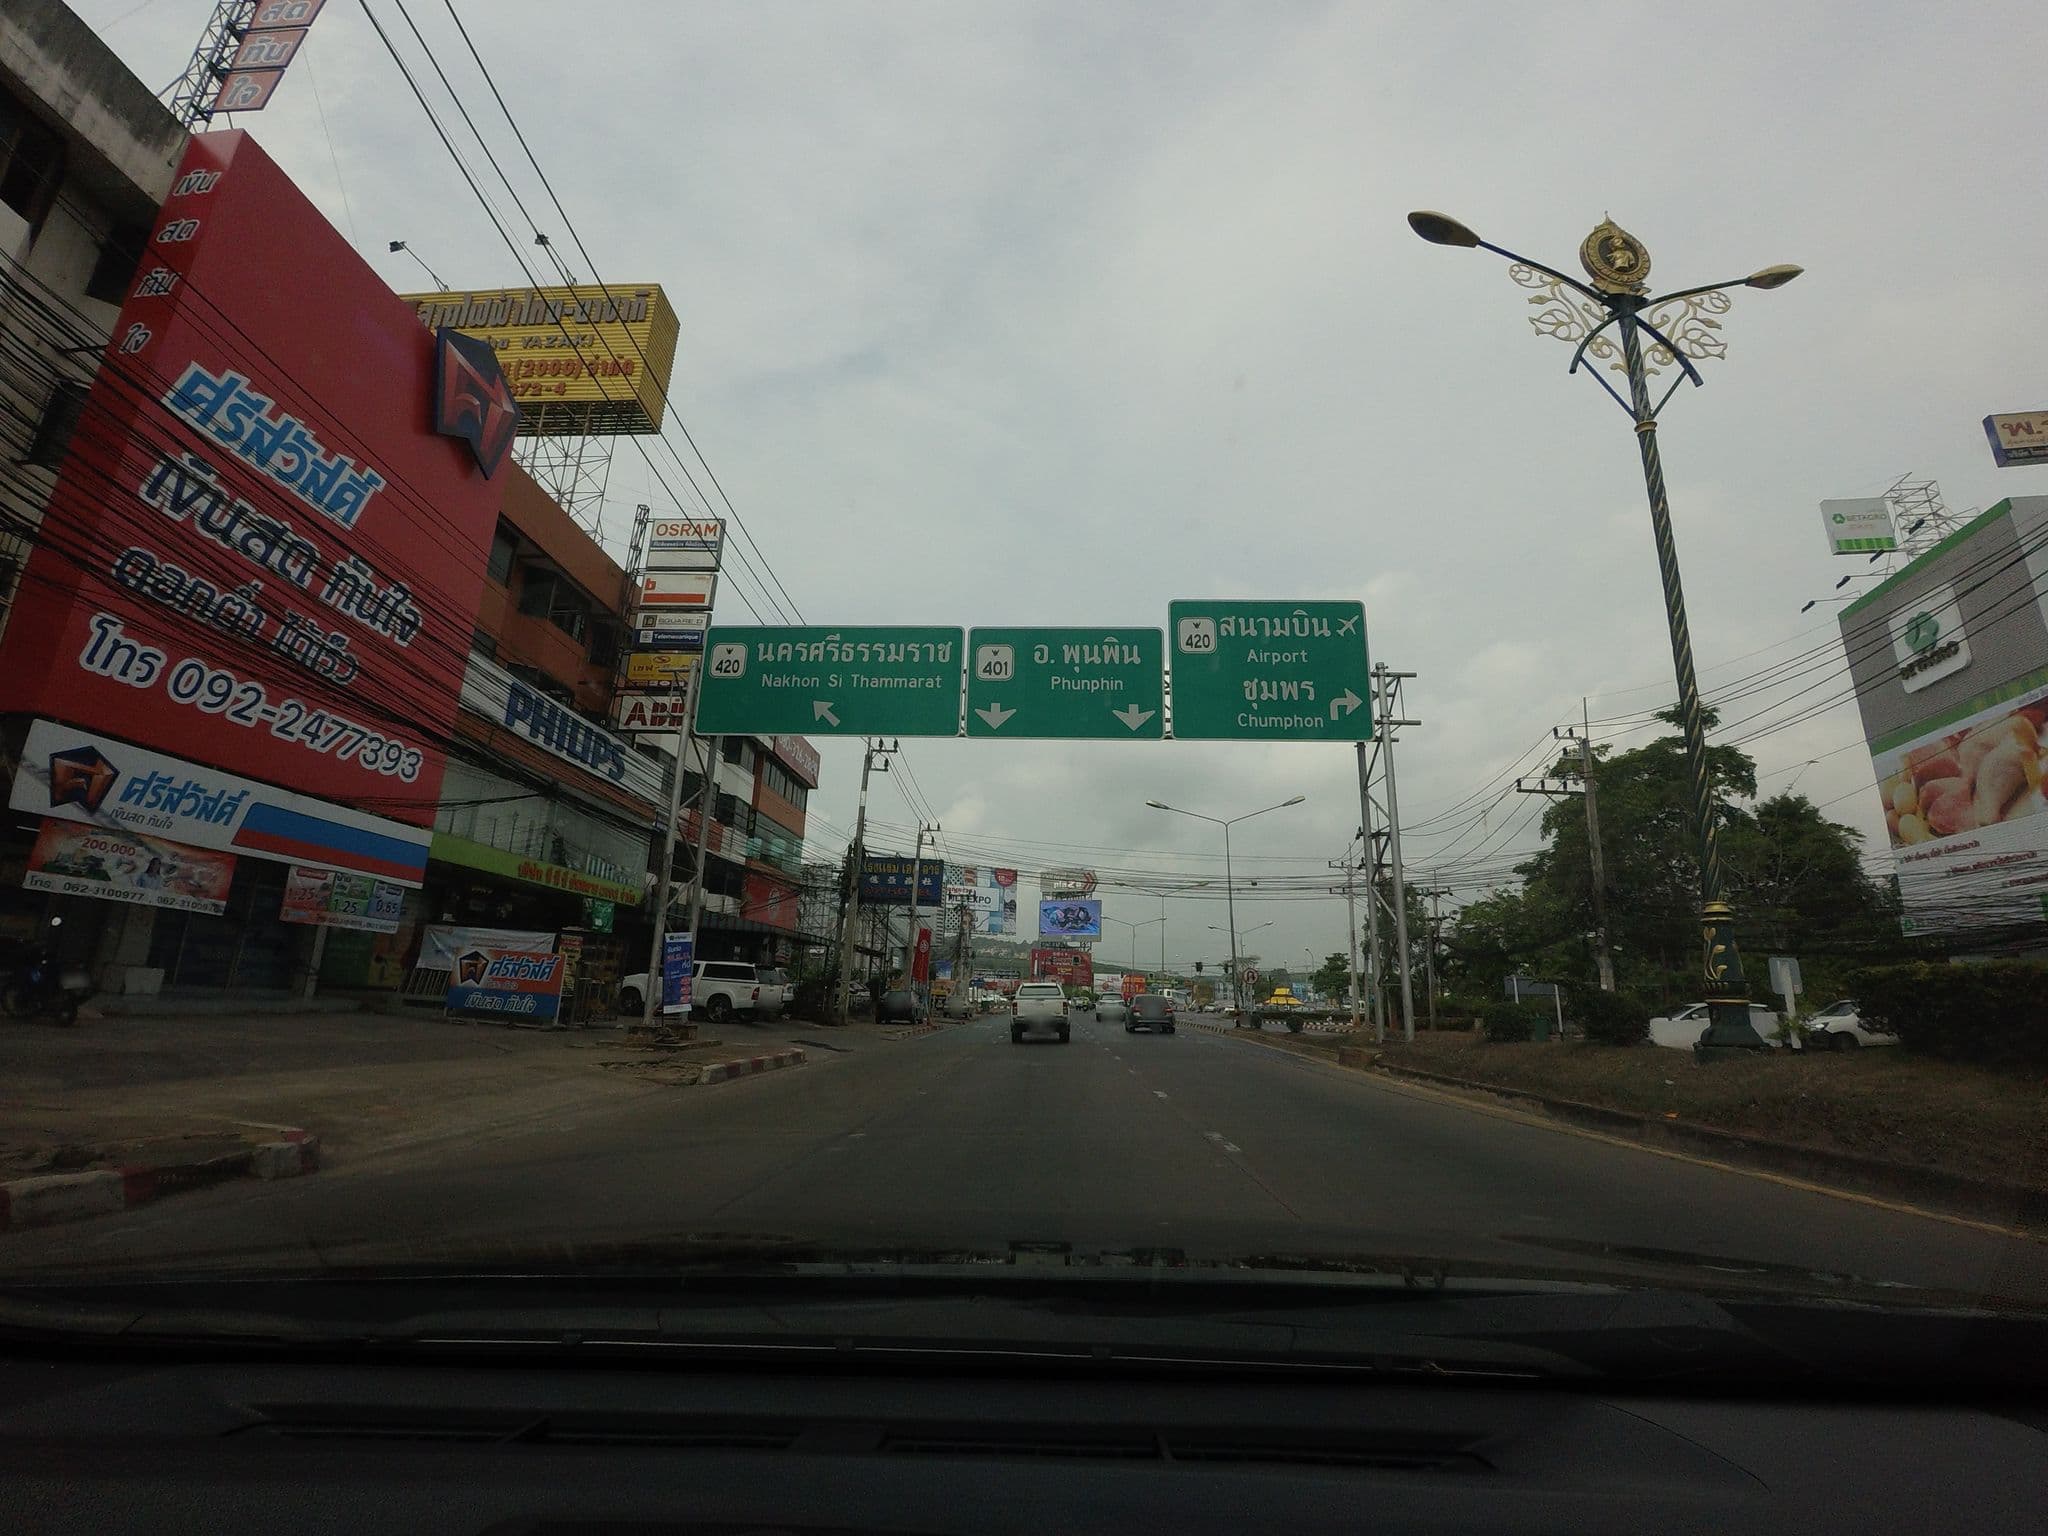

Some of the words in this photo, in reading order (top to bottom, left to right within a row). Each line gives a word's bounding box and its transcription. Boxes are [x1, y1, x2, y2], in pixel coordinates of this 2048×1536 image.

[156, 219, 200, 243] สด
[522, 335, 595, 349] YAZAKI
[138, 452, 321, 591] เงินสด
[656, 523, 717, 537] OSRAM
[1219, 609, 1332, 638] สนามบิน
[757, 633, 953, 663] นครศรีธรรมราช
[1185, 634, 1211, 649] 420
[1033, 644, 1056, 664] อ.
[1063, 636, 1141, 673] พุนพิน
[1247, 648, 1308, 665] Airport
[715, 660, 740, 674] 420
[982, 661, 1009, 676] 401
[761, 674, 820, 688] Nakhon
[828, 674, 843, 688] Si
[851, 674, 942, 689] Thammarat
[1051, 675, 1124, 695] Phunphin
[80, 611, 168, 689] โทร
[167, 657, 423, 783] 092-2477393
[1242, 678, 1315, 710] ชุมพร
[1237, 712, 1324, 730] Chumphon
[504, 681, 626, 782] PHILIPS
[82, 838, 137, 857] 200,000
